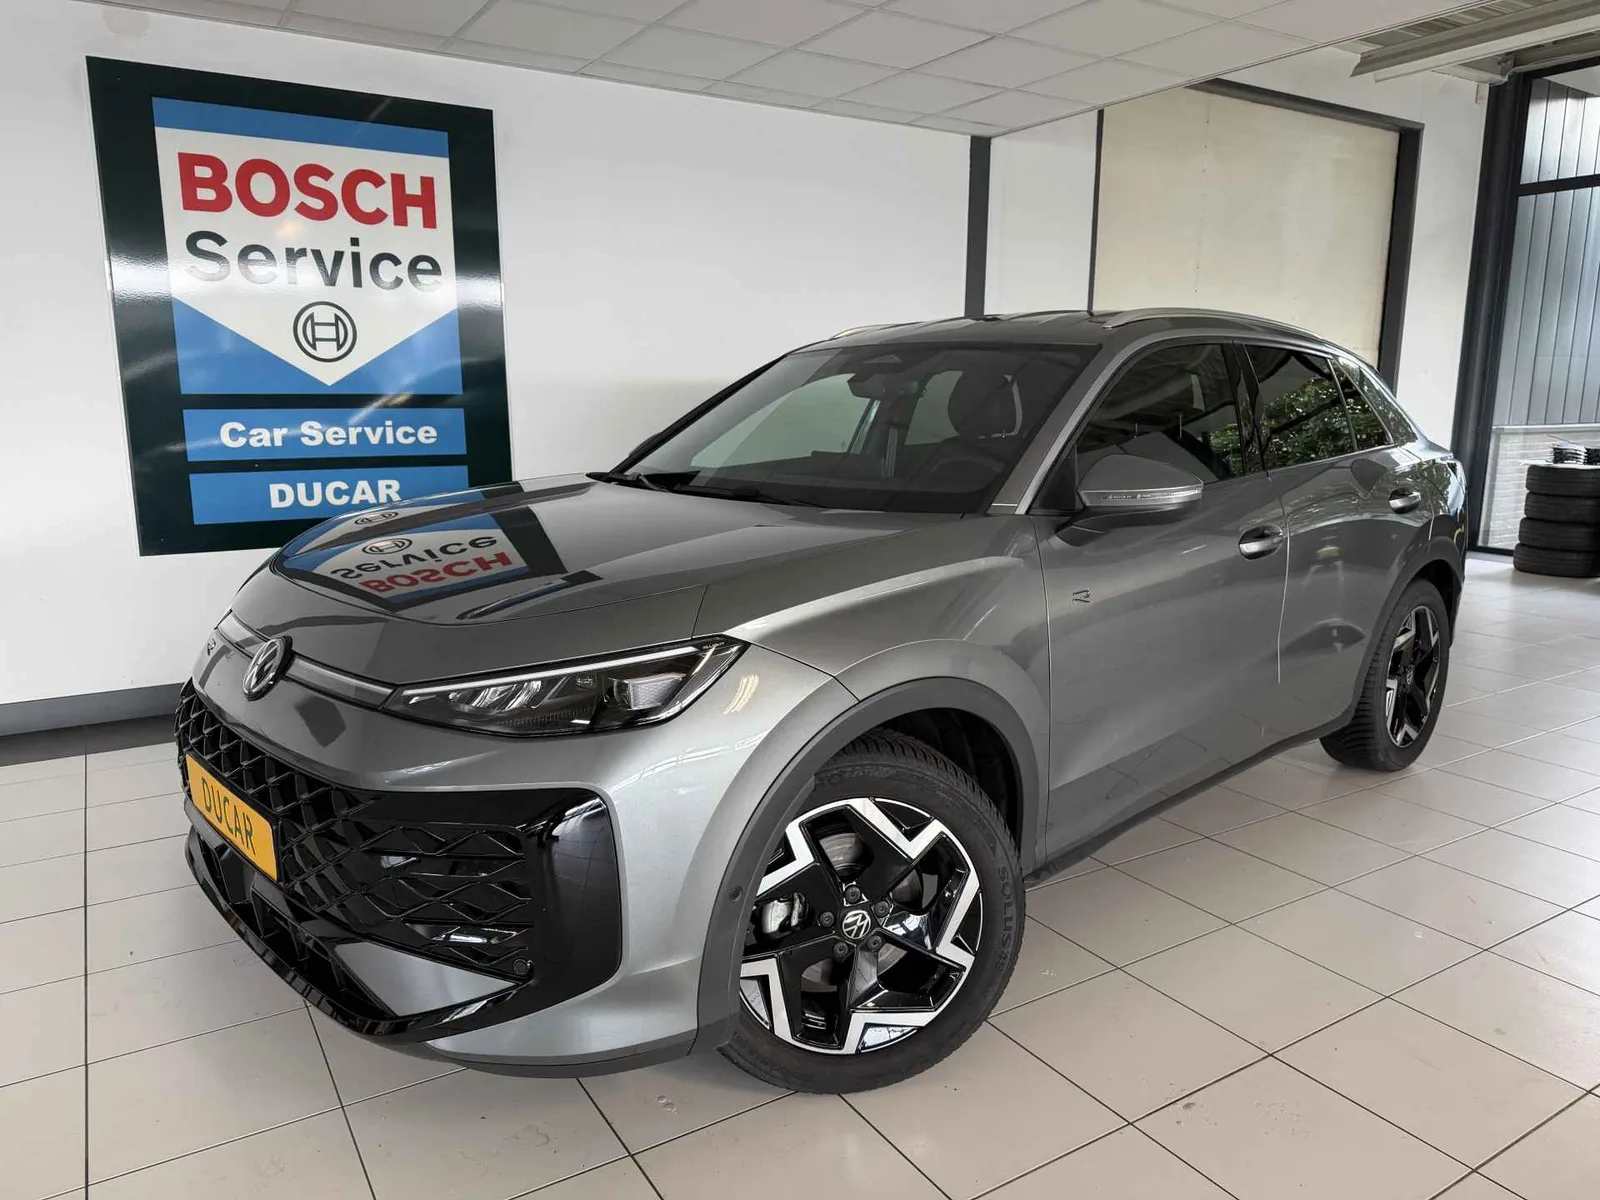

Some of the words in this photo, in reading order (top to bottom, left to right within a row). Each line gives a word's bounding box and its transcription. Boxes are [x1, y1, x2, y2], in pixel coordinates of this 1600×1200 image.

[178, 152, 437, 229] BOSCH
[185, 231, 442, 290] Service
[219, 421, 287, 448] Car
[300, 419, 438, 446] Service
[269, 480, 401, 508] DUCAR
[201, 776, 256, 855] DUCAR
